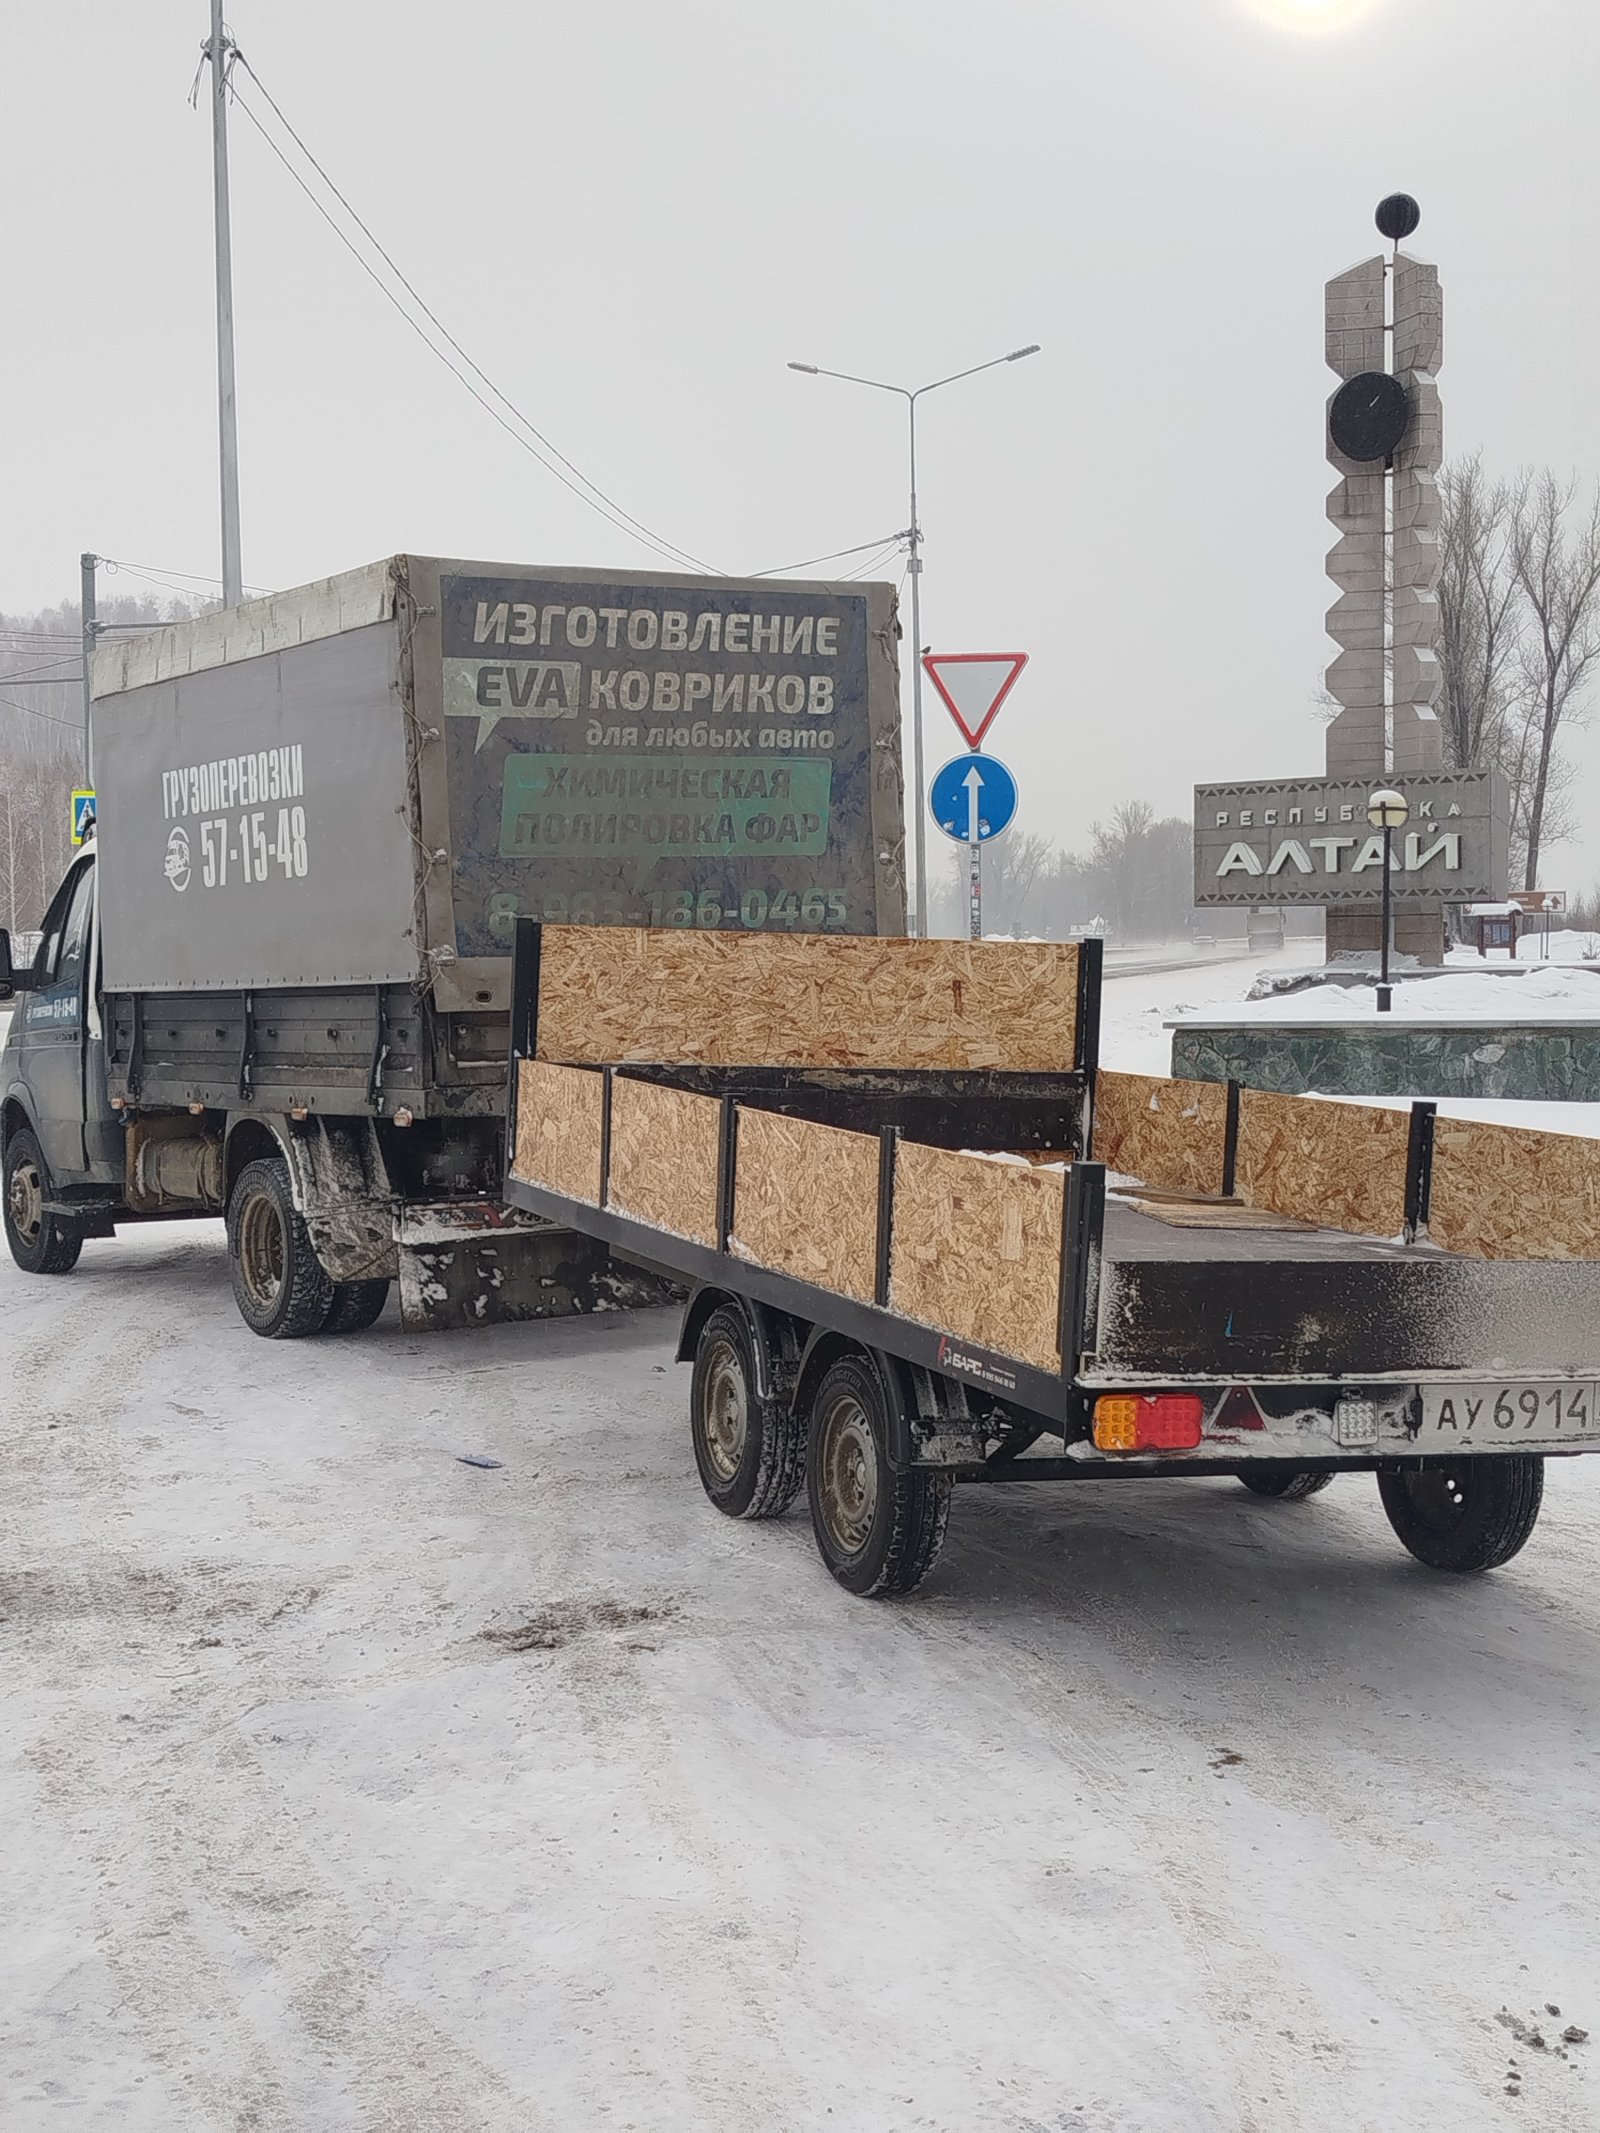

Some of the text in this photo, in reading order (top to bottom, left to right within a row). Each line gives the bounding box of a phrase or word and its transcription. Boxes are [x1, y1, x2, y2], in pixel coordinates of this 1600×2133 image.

[474, 601, 841, 656] ИЗГОТОВЛЕНИЕ
[476, 666, 835, 715] EVA КОВРИКОВ
[585, 721, 836, 749] для любых авто
[162, 744, 304, 819] ГРУЗОПЕРЕВОЗКИ
[542, 766, 792, 800] ХИМИЧЕСКАЯ
[514, 813, 822, 846] ПОЛИРОВКА ФАР
[1216, 801, 1462, 827] РЕСПУБКА
[200, 806, 309, 888] 57-15-48
[1215, 822, 1462, 877] АЛТАЙ
